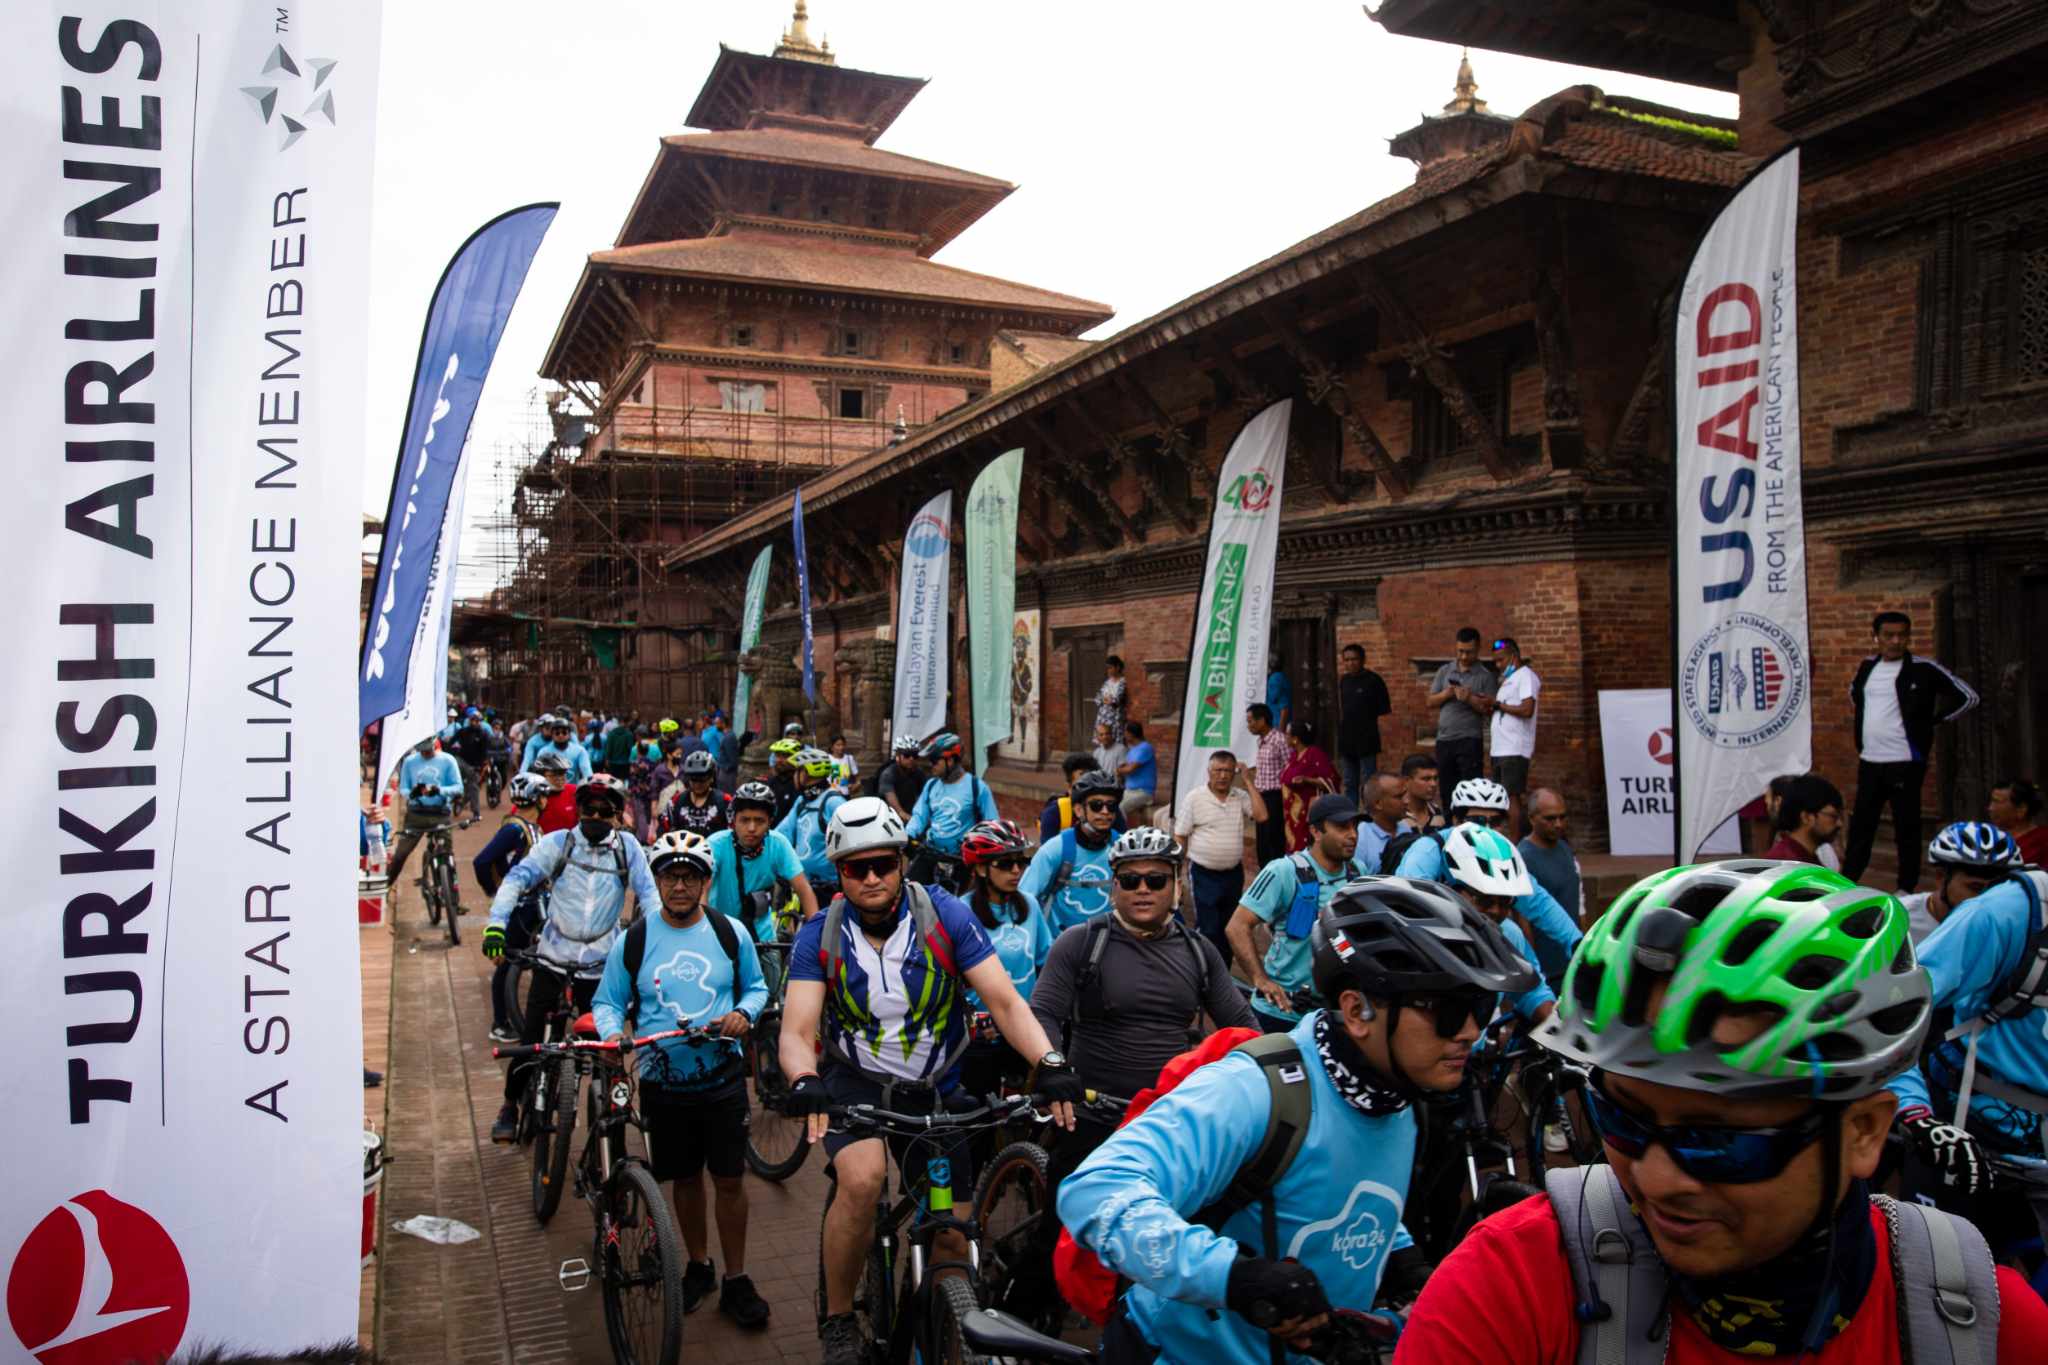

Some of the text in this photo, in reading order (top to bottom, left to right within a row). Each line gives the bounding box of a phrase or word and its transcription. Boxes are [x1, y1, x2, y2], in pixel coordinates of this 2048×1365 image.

[276, 8, 288, 33] TM
[1696, 282, 1761, 603] USAID
[1765, 355, 1784, 472] AMERICAN
[1766, 479, 1784, 523] THE
[55, 16, 162, 1125] TURKISH AIRLINES
[1767, 529, 1787, 594] FROM
[244, 187, 308, 1123] A STAR ALLIANCE MEMBER
[904, 562, 927, 719] Himalayan Everest
[924, 636, 937, 700] Insurance
[1203, 559, 1240, 739] NABIL BANK
[1685, 667, 1696, 709] STATES
[1710, 658, 1721, 710] USAID
[1737, 673, 1804, 745] INTERNATIONAL
